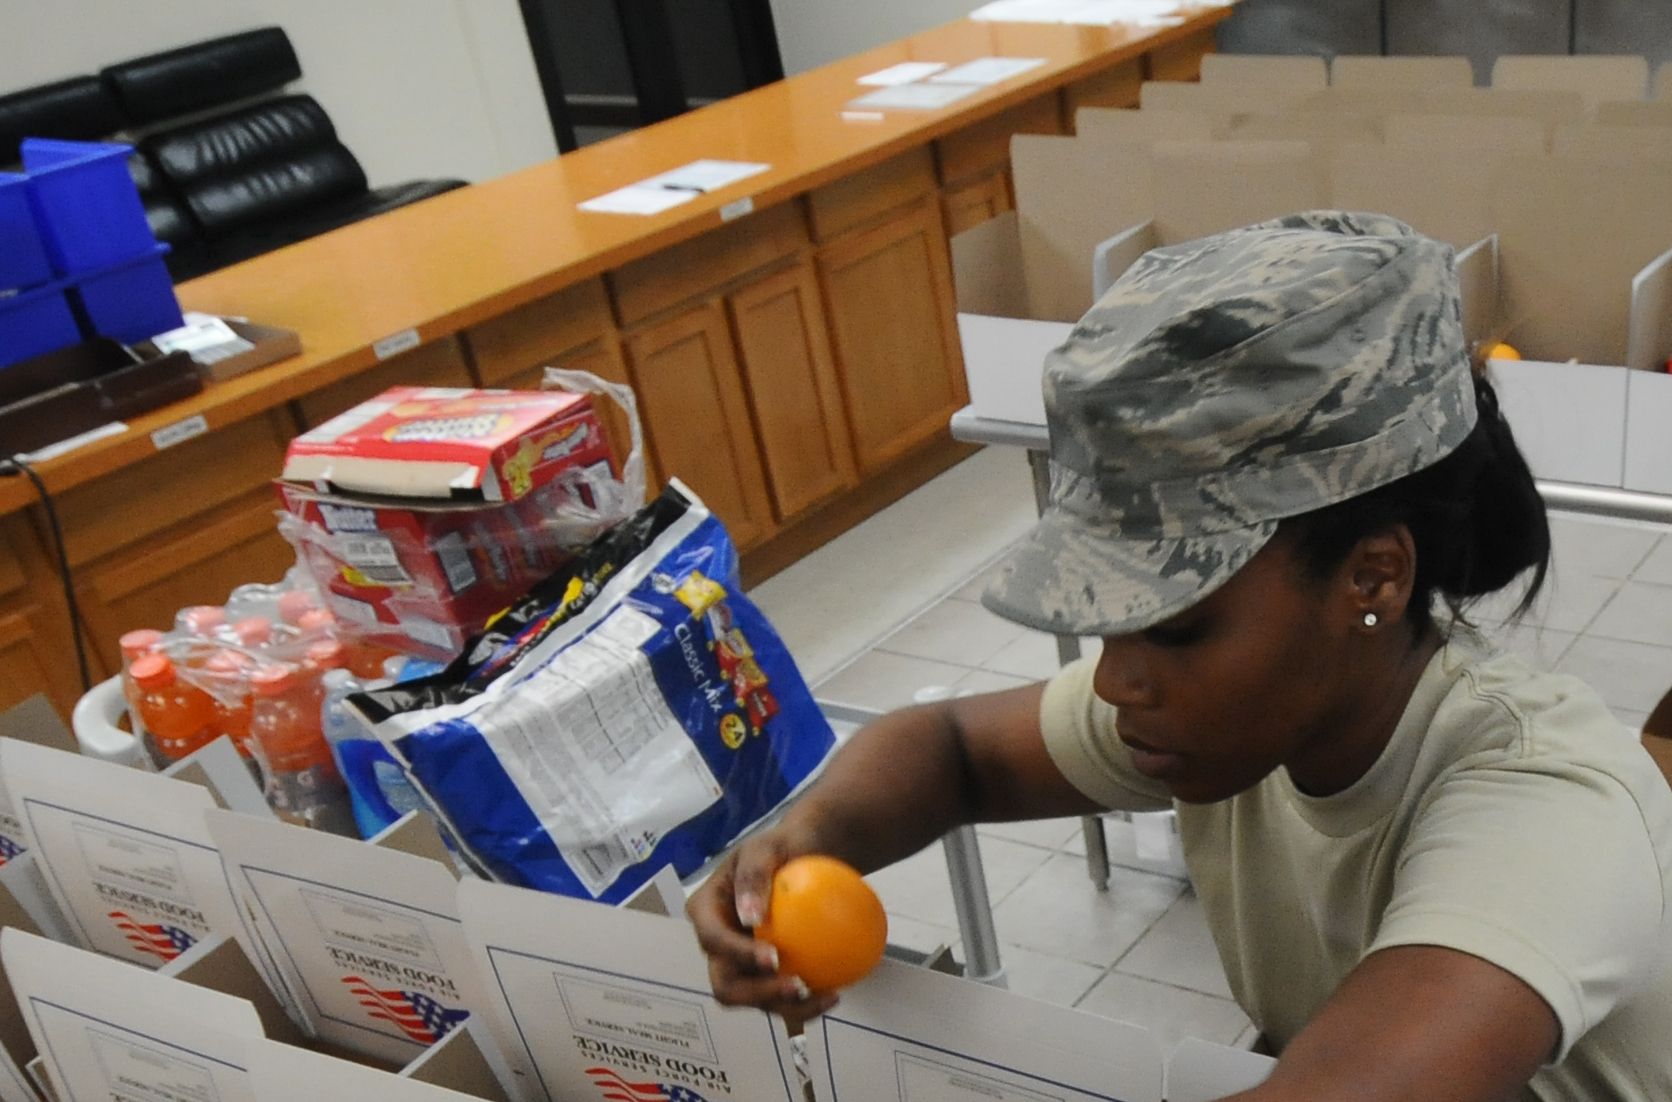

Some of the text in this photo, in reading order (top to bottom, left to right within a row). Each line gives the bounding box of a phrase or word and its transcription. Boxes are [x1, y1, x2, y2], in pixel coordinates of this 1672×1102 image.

[674, 623, 722, 713] Classic Mix
[326, 946, 458, 992] FOOD SERVICE
[573, 1036, 731, 1085] FOOD SERVICE
